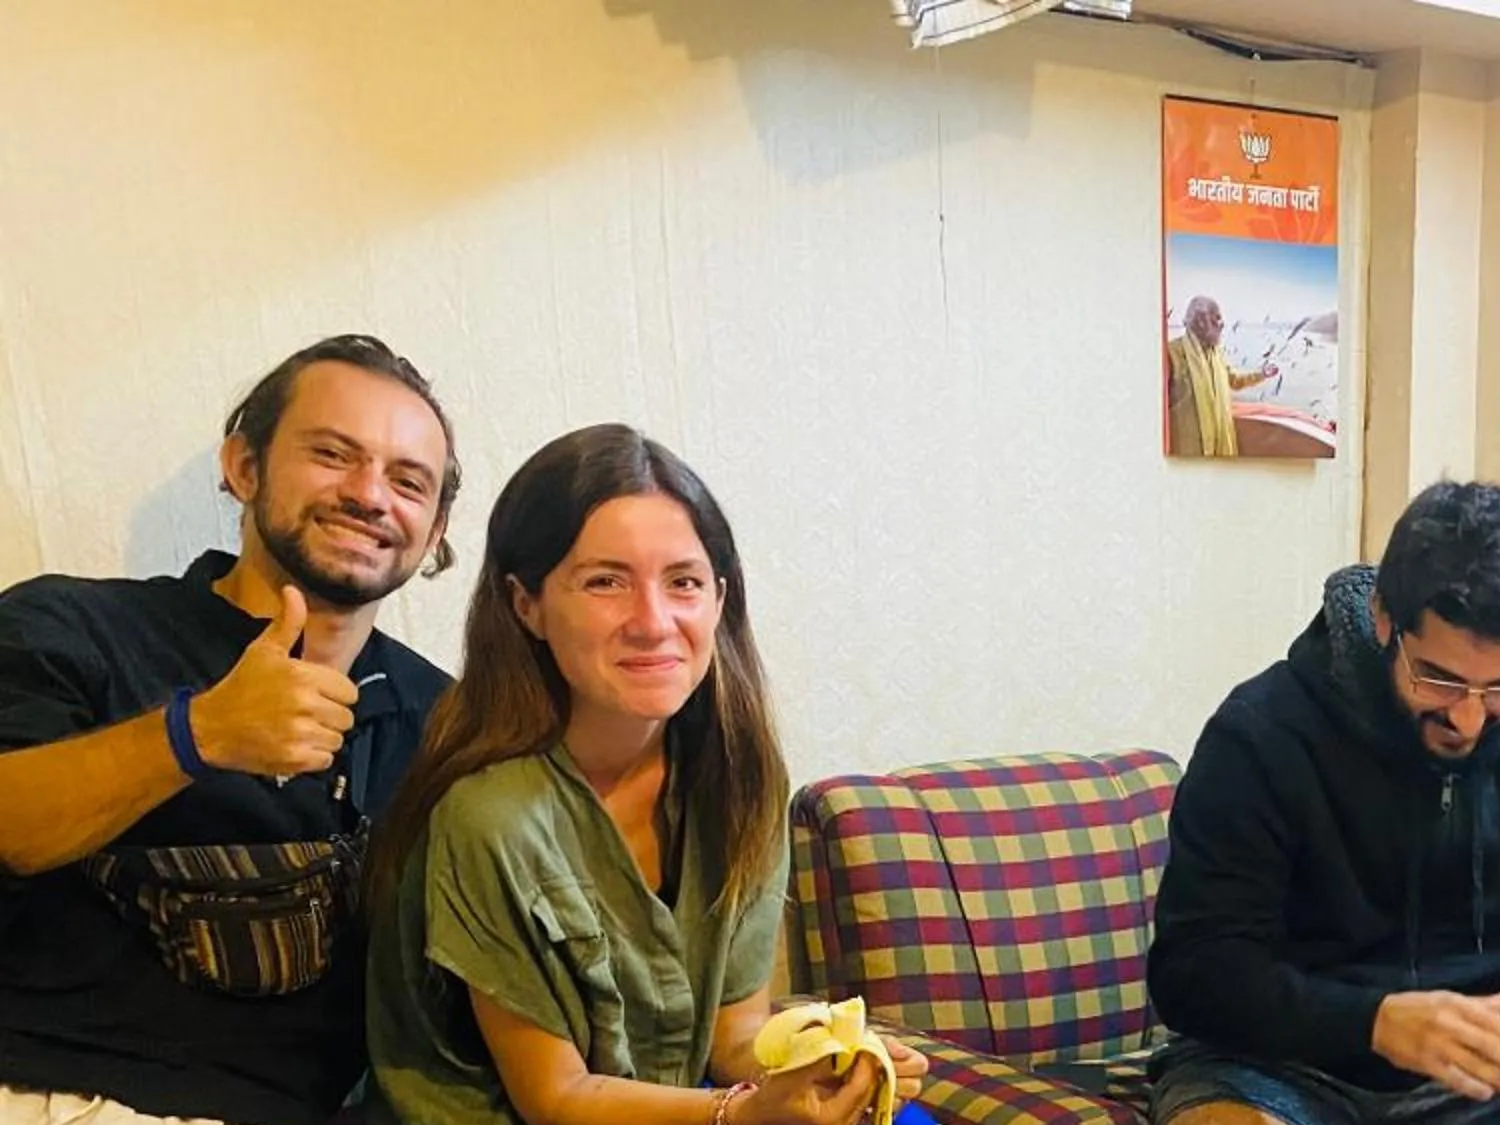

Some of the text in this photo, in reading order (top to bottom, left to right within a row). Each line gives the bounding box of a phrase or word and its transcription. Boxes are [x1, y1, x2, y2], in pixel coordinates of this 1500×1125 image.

[1187, 175, 1320, 212] भारतीय जनता पार्टी
